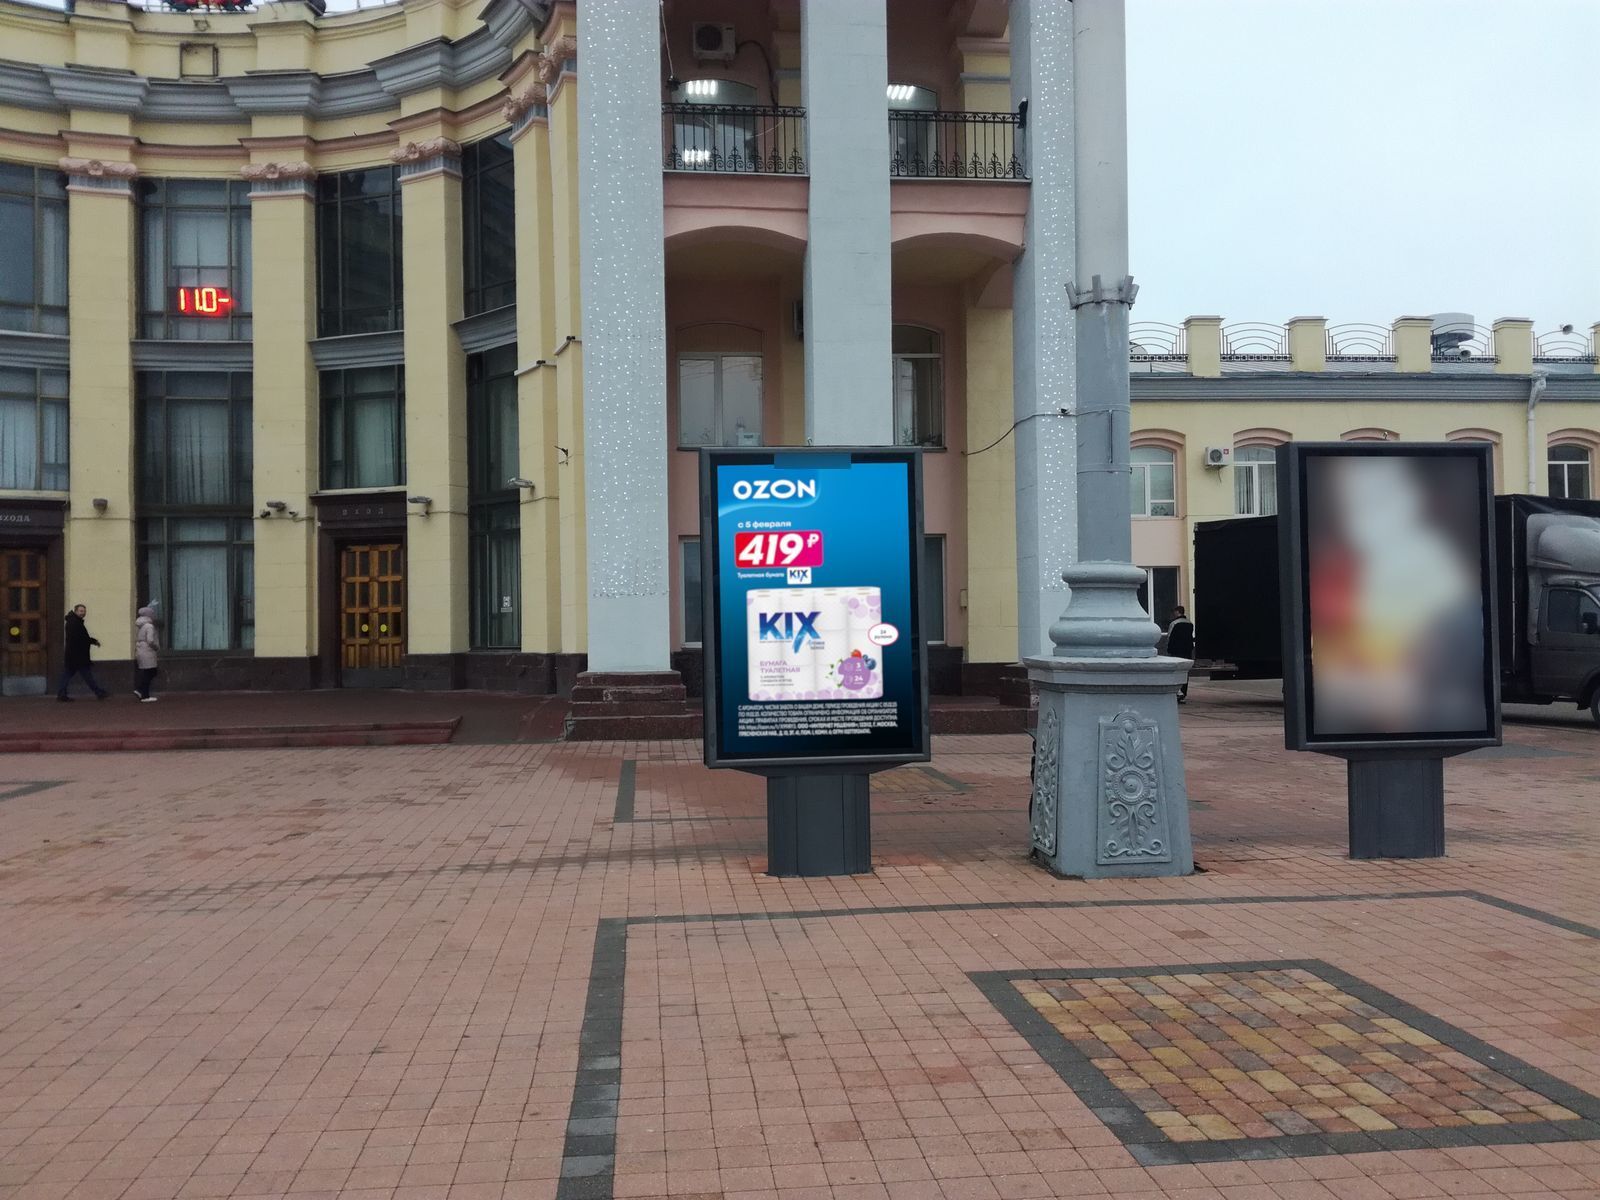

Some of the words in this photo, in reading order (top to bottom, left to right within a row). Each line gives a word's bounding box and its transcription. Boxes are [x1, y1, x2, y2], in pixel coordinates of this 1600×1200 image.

[733, 479, 816, 500] OZON
[752, 520, 792, 529] февраля
[789, 569, 808, 582] KIX
[759, 611, 821, 654] KIX
